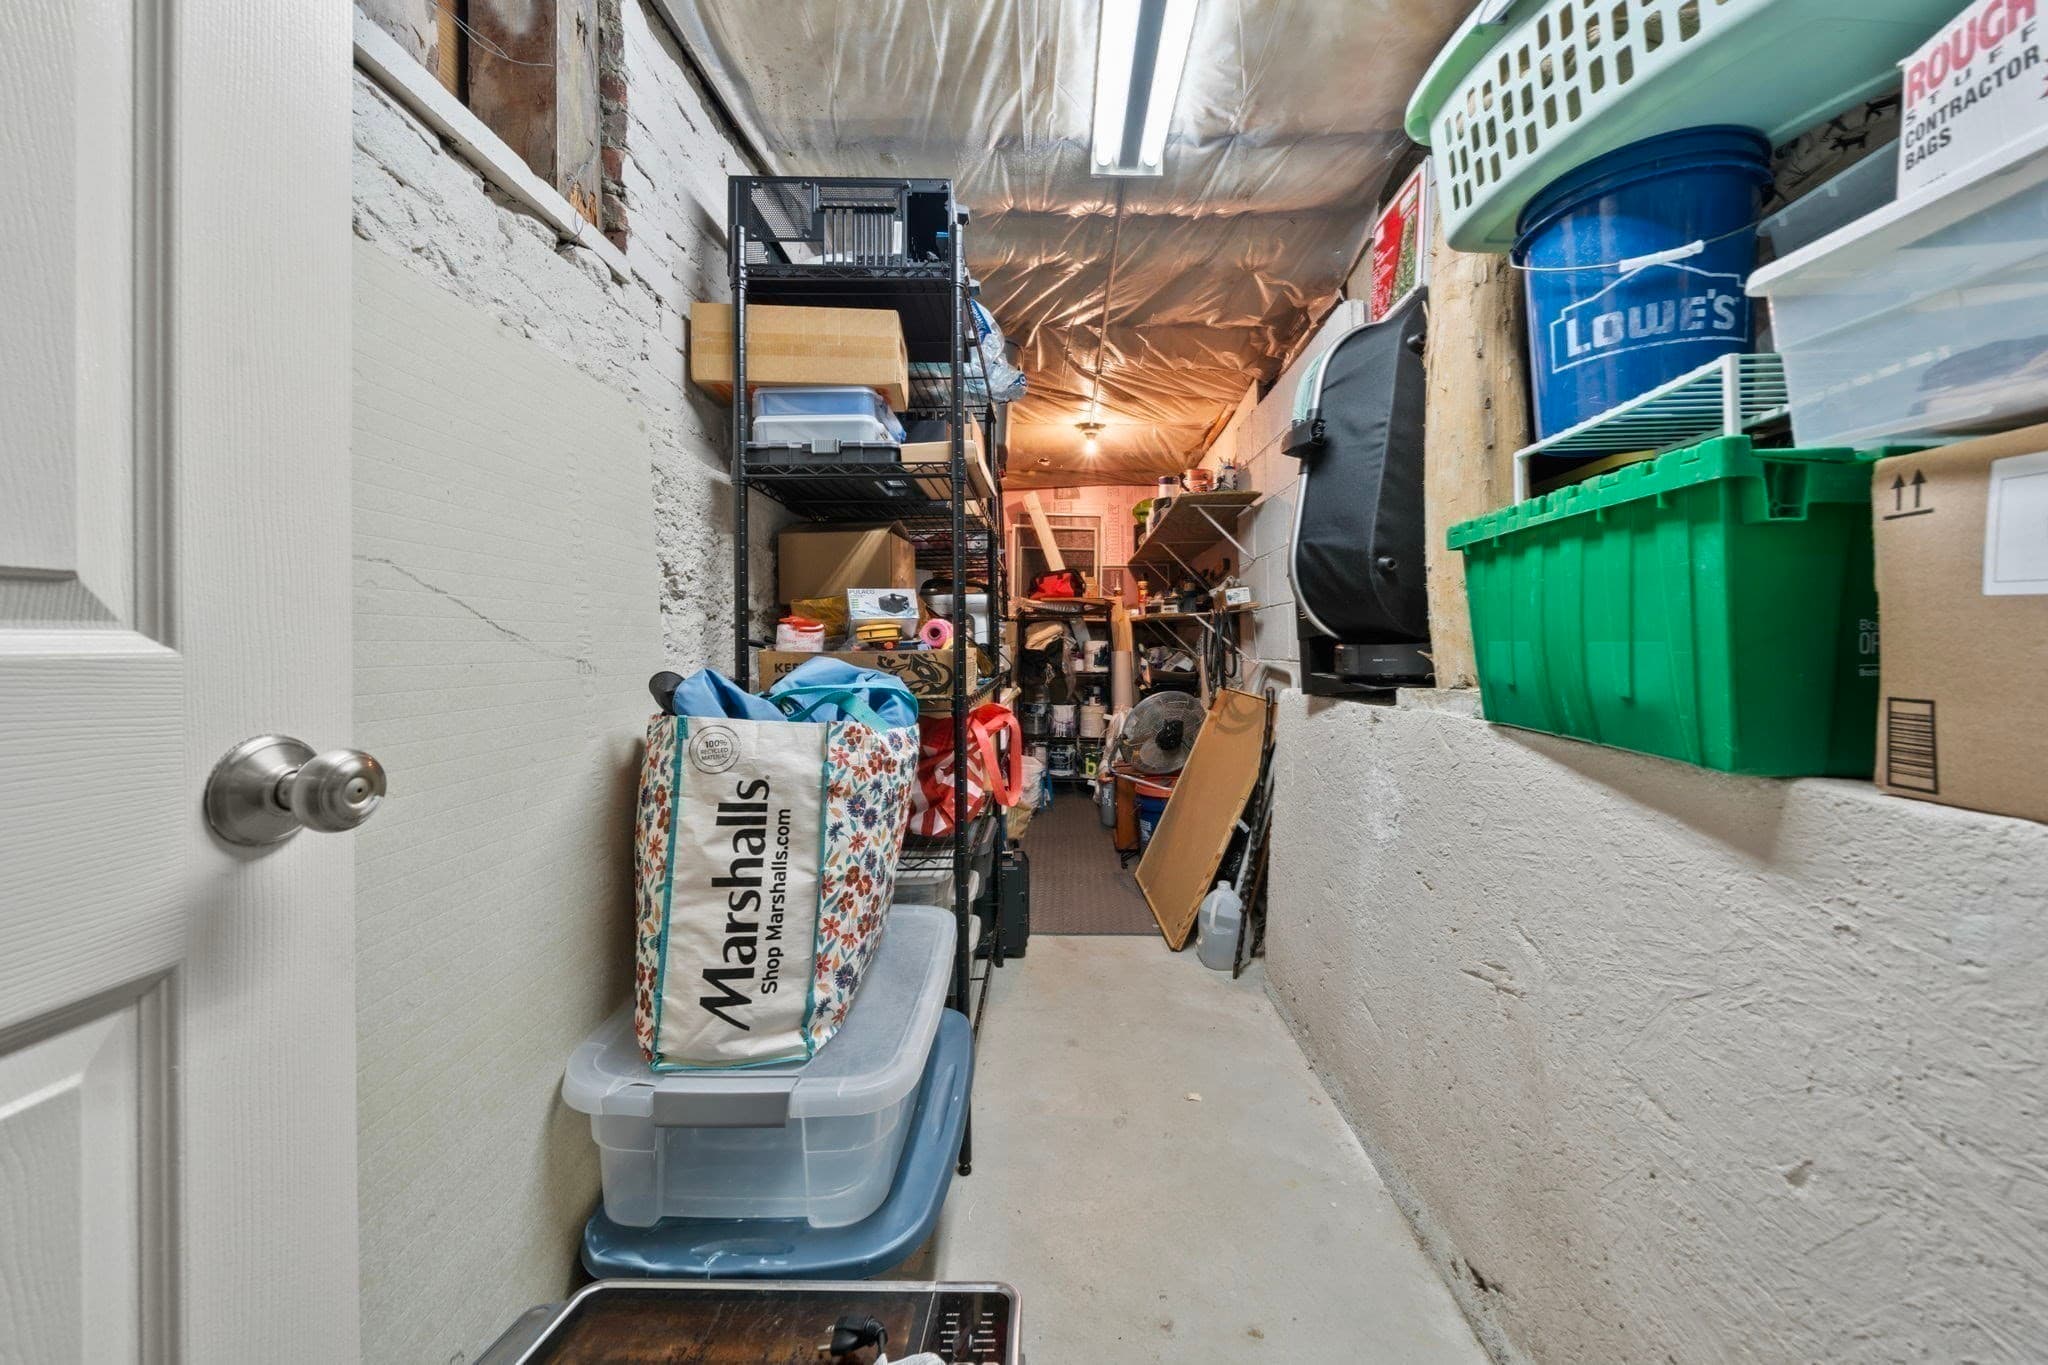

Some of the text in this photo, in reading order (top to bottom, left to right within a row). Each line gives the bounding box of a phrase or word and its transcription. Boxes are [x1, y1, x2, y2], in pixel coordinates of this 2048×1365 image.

[1905, 45, 2041, 149] CONTRACTOR
[1906, 0, 2036, 109] ROUGH
[1905, 128, 1952, 171] BAGS
[1566, 288, 1738, 358] LOWE'S
[700, 747, 729, 755] RECYCLED
[705, 739, 728, 748] 100%
[699, 778, 770, 1032] Marshalls
[762, 808, 792, 995] Shop Marshalls.com
